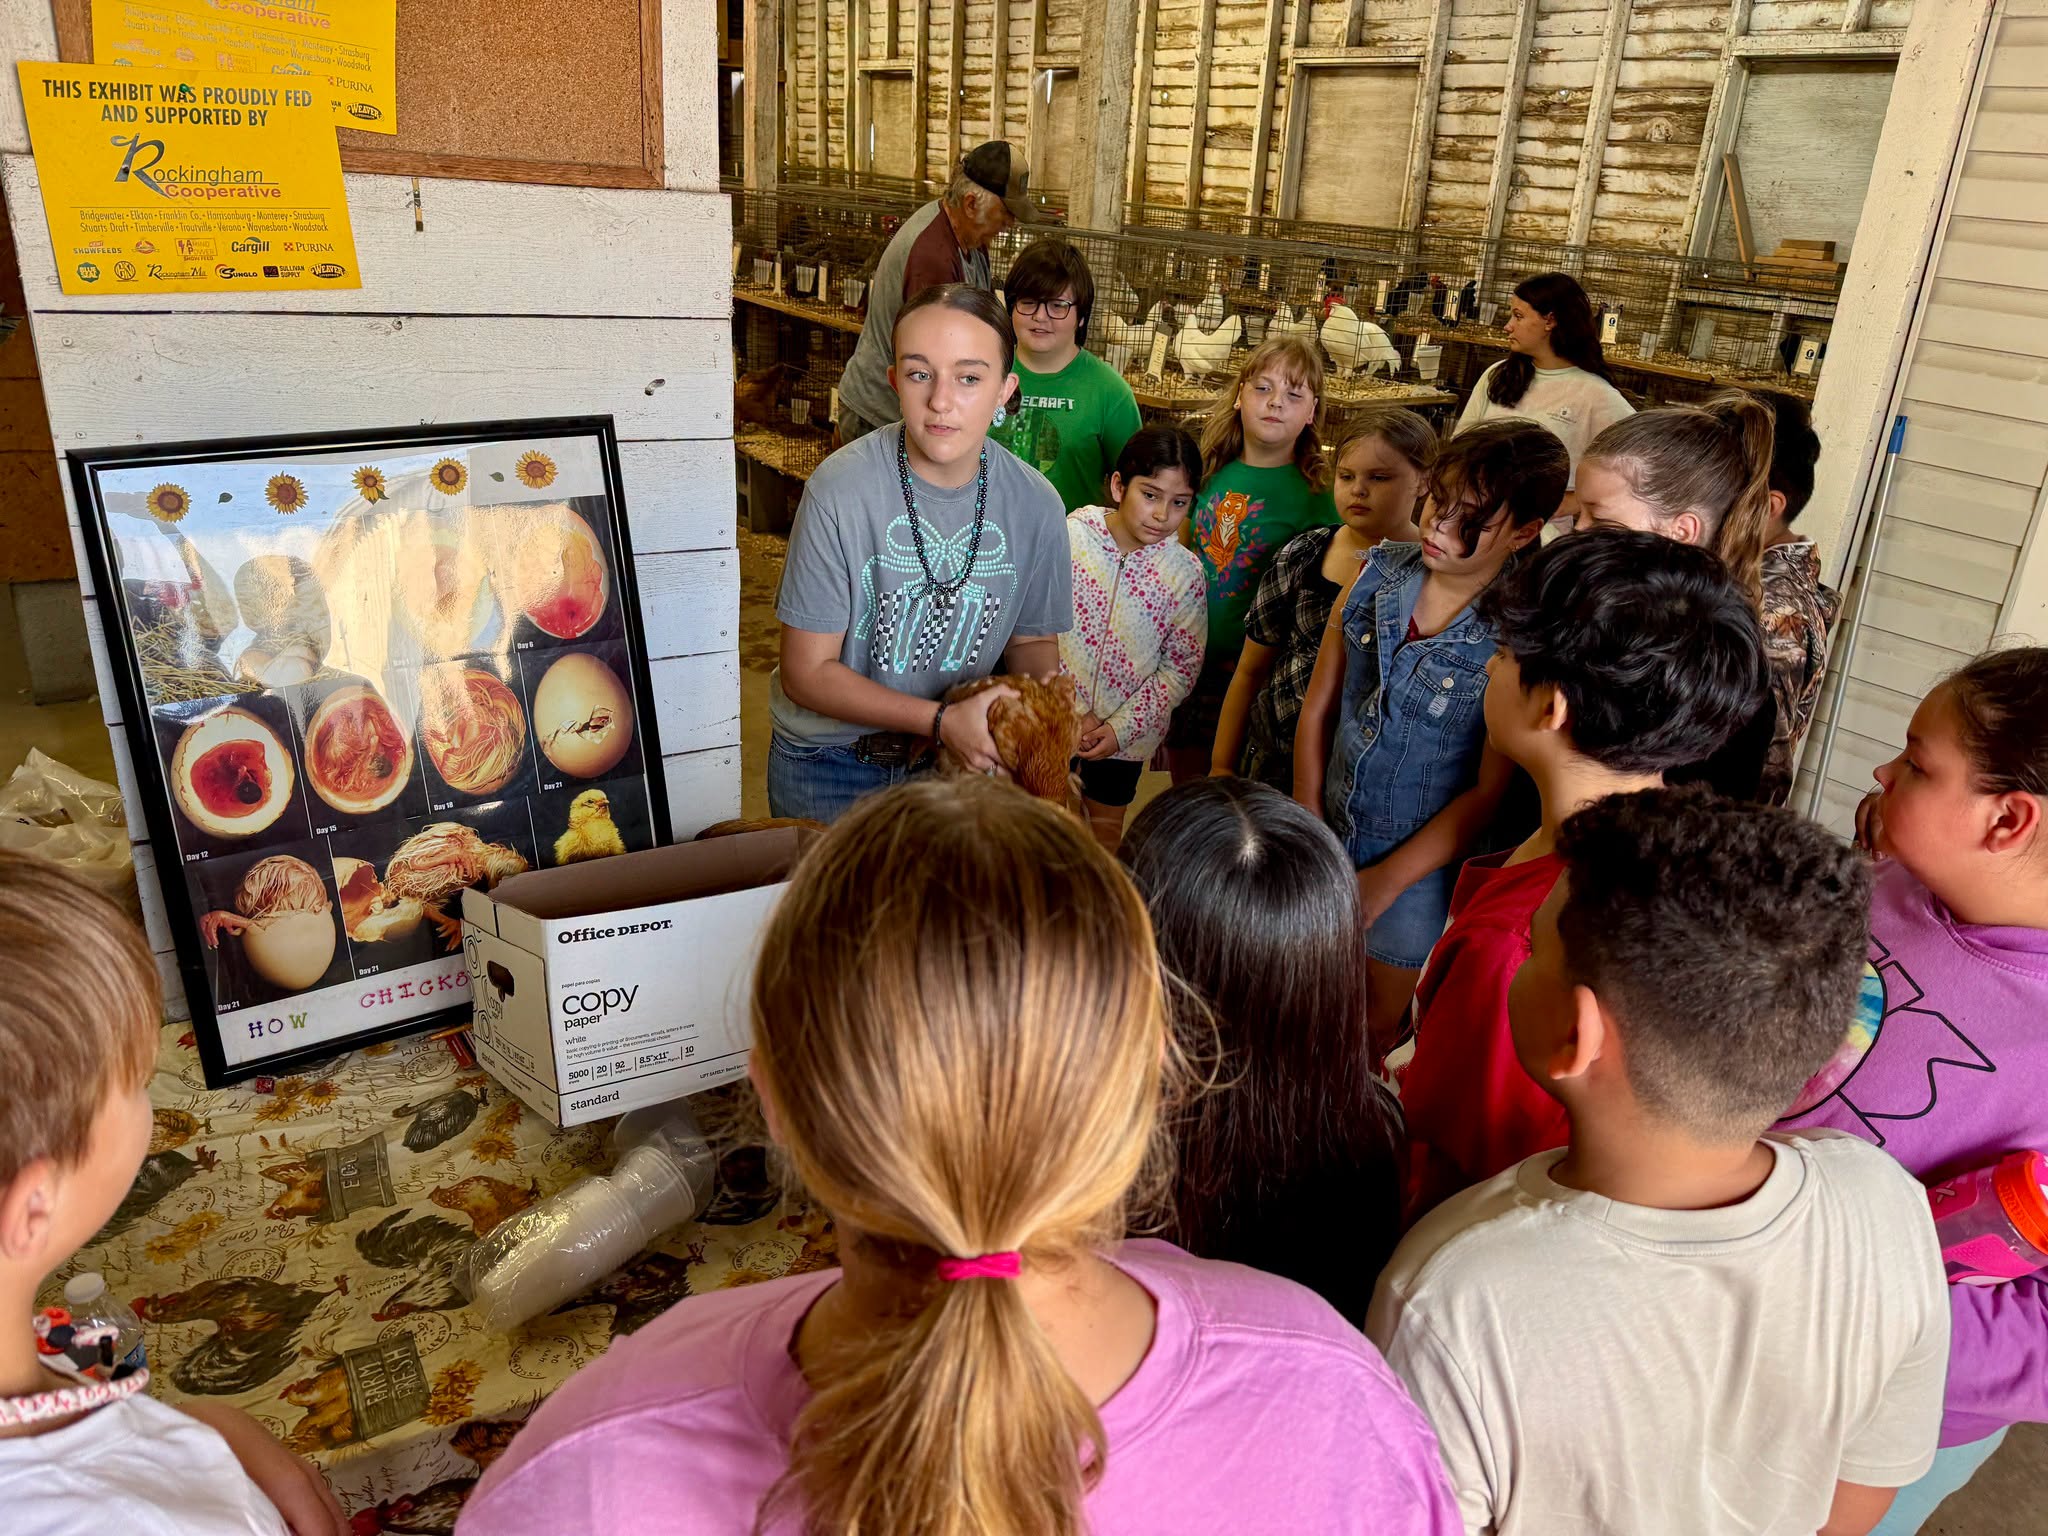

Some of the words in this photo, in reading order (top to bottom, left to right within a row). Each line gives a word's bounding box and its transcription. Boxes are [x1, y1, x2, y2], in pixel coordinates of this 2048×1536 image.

[338, 45, 370, 61] Strasburg
[336, 57, 373, 72] Woodstock
[335, 76, 374, 94] PURINA
[42, 79, 82, 99] THIS
[88, 81, 153, 102] EXHIBIT
[159, 84, 197, 104] WAS
[203, 87, 279, 107] PROUDLY
[285, 90, 313, 108] FED
[101, 104, 138, 123] AND
[145, 106, 242, 126] SUPPORTED
[248, 109, 268, 127] BY
[110, 132, 264, 199] Rockingham
[164, 184, 282, 201] Cooperative
[80, 209, 125, 222] Bridgewater
[130, 209, 154, 220] Elkton
[158, 209, 188, 220] Franklin
[190, 209, 202, 221] Co.
[206, 209, 252, 222] Harrisonburg
[256, 210, 289, 222] Monterey
[293, 210, 326, 222] Strasburg
[80, 222, 108, 233] Stuarts
[109, 221, 129, 232] Draft
[134, 221, 175, 232] Timberville
[179, 221, 212, 232] Troutville
[217, 221, 242, 232] Verona
[245, 221, 288, 233] Waynesboro
[292, 221, 329, 232] Woodstock
[231, 240, 270, 255] Cargill
[295, 241, 335, 252] PURINA
[1021, 395, 1075, 410] ECRAFT
[517, 642, 528, 650] Day
[544, 783, 556, 791] Day
[556, 781, 563, 789] 21
[316, 826, 329, 835] Day
[186, 852, 200, 862] Day
[200, 850, 209, 858] 12
[558, 927, 616, 944] Office
[358, 967, 371, 976] Day
[371, 965, 379, 973] 21
[217, 1002, 231, 1012] Day
[231, 1000, 240, 1009] 21
[562, 984, 640, 1016] copy
[248, 1011, 308, 1039] HOW
[564, 1014, 603, 1032] paper
[565, 1036, 587, 1046] white
[579, 1043, 597, 1052] copying
[602, 1038, 619, 1047] printing
[573, 1050, 585, 1059] high
[585, 1047, 601, 1056] volume
[568, 1068, 590, 1080] 5000
[596, 1065, 608, 1074] 20
[614, 1060, 626, 1070] 92
[685, 1045, 695, 1054] 10
[570, 1090, 620, 1111] standard
[263, 1222, 299, 1239] Post
[384, 1345, 424, 1399] FRESH
[357, 1360, 389, 1407] FARM
